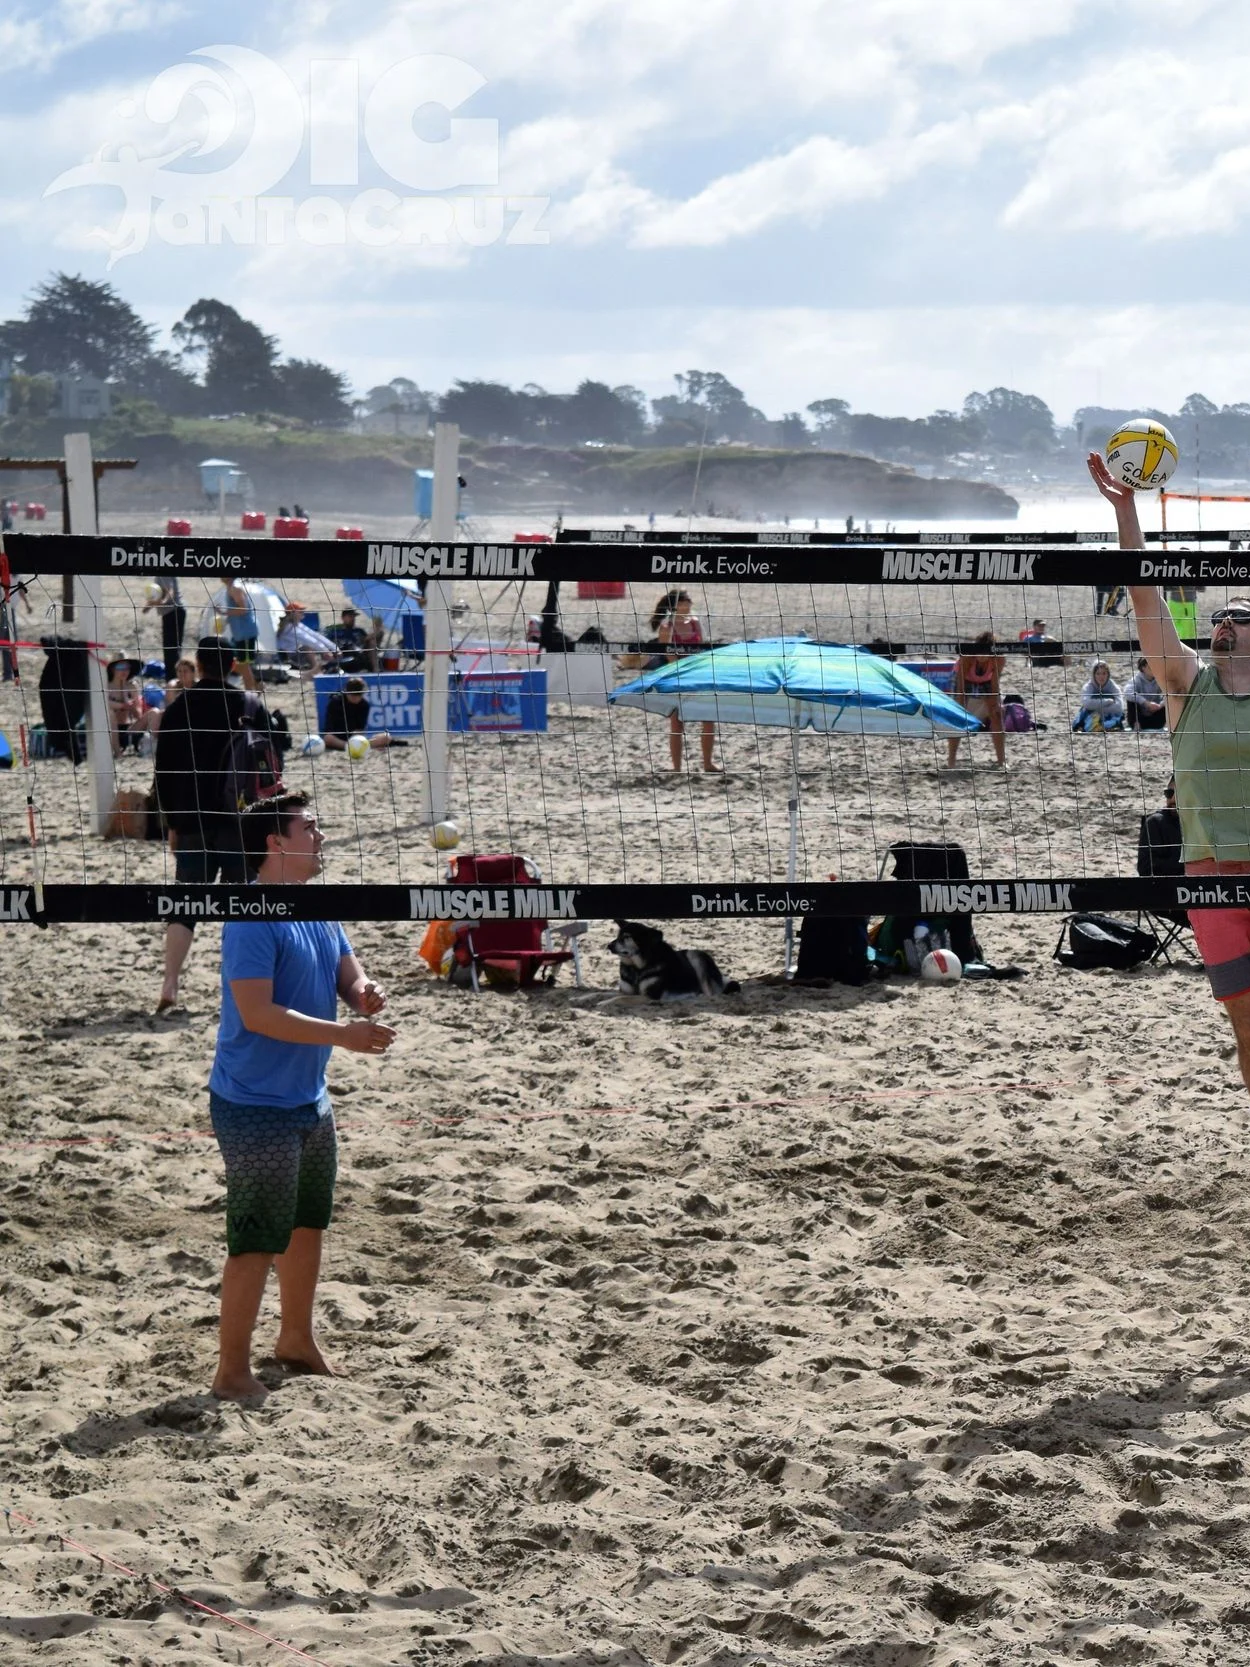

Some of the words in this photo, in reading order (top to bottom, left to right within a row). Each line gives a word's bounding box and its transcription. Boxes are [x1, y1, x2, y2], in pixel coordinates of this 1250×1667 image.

[758, 533, 789, 543] MUSCLE
[791, 534, 810, 543] MILK
[919, 534, 949, 543] MUSCLE
[951, 534, 970, 543] MILK
[112, 547, 179, 567] Drink.
[367, 545, 467, 576] MUSCLE
[472, 546, 535, 575] MILK
[651, 555, 713, 574] Drink.
[882, 551, 974, 580] MUSCLE
[977, 552, 1036, 580] MILK
[1140, 559, 1196, 577] Drink.
[363, 685, 409, 706] UD
[368, 705, 421, 728] GHT
[410, 889, 509, 919] MUSCLE
[514, 889, 576, 918] MILK
[692, 893, 753, 912] Drink.
[920, 885, 1010, 912] MUSCLE
[1014, 883, 1071, 911] MILK
[1177, 885, 1233, 903] Drink.
[158, 895, 225, 915] Drink.
